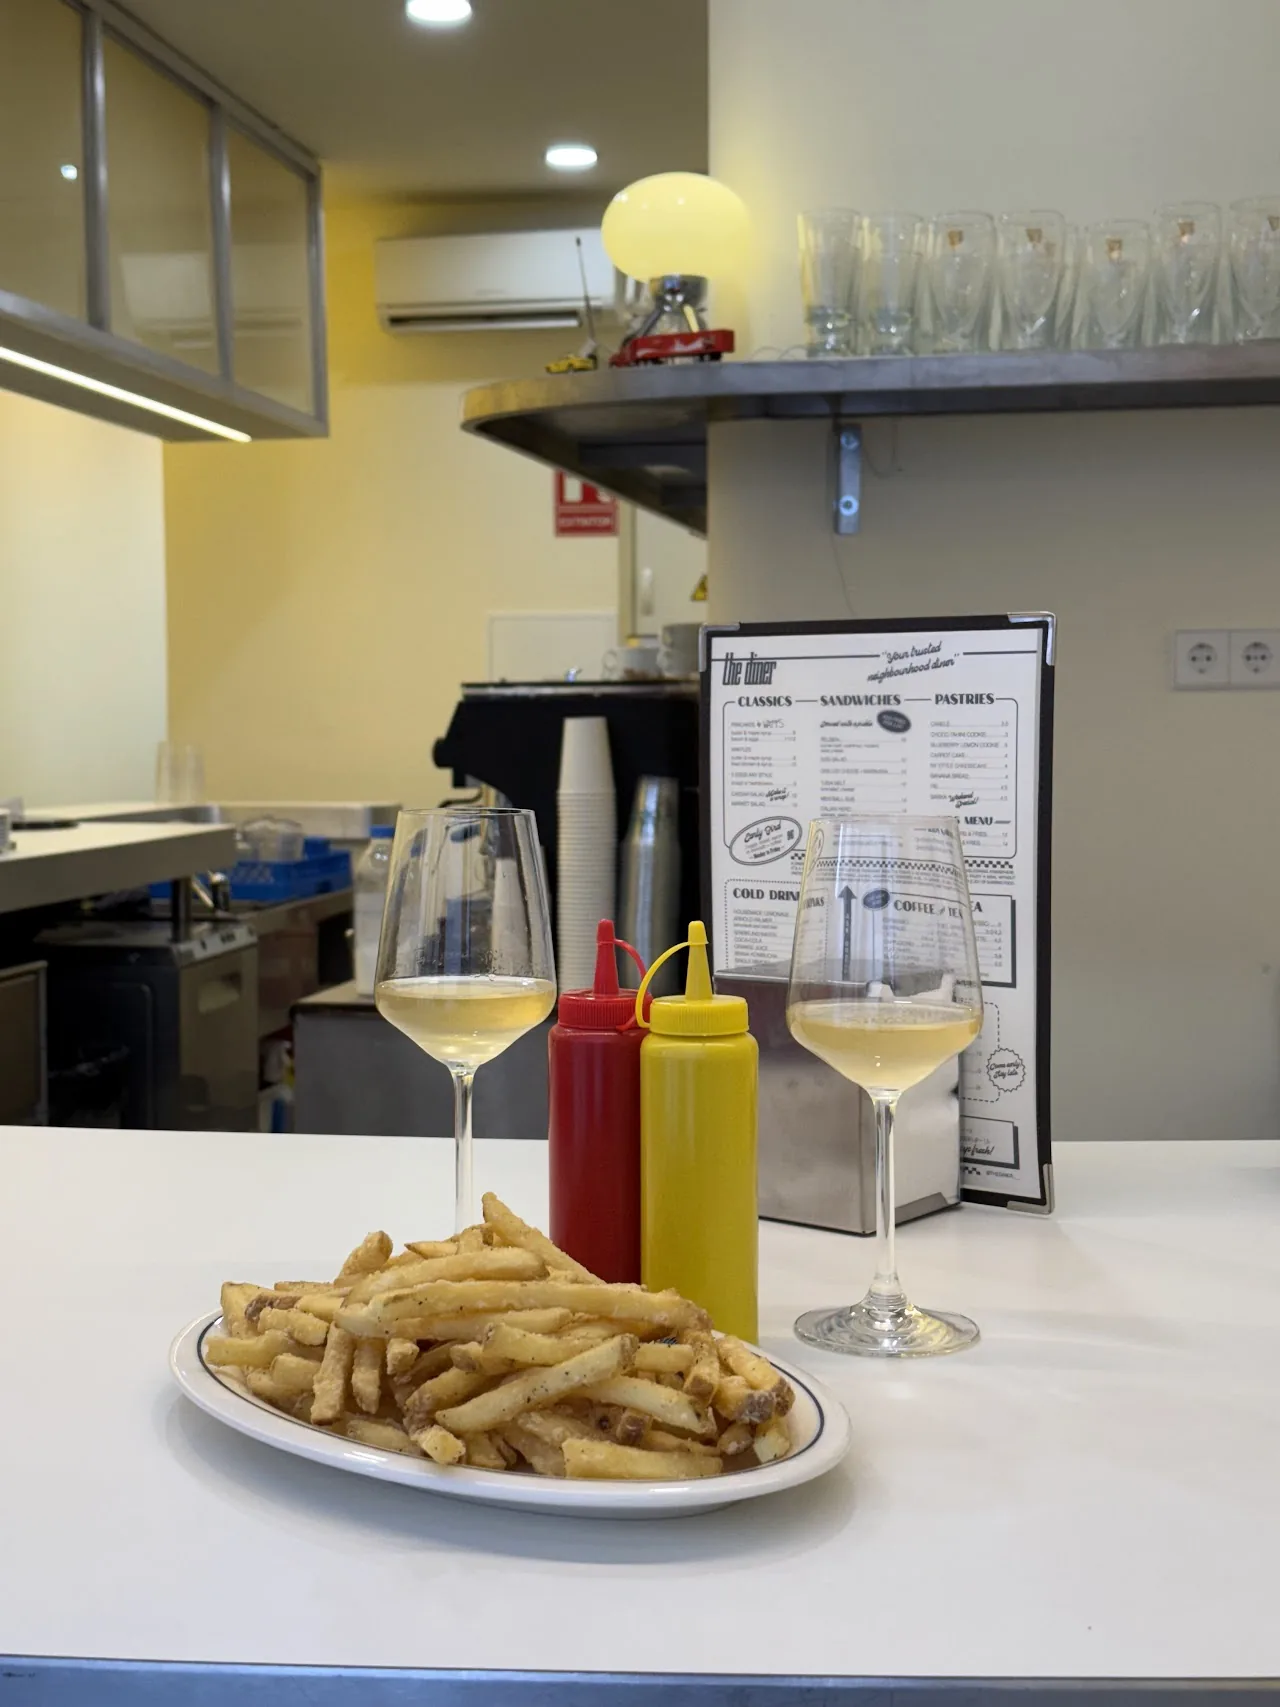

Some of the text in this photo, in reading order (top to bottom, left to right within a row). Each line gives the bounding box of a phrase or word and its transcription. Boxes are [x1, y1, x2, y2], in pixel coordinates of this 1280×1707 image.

[910, 641, 942, 658] trusted
[722, 652, 777, 686] the diner
[867, 658, 932, 684] neighbourhood
[738, 695, 792, 707] CLASSICS
[820, 694, 901, 706] SANDWICHES
[935, 693, 995, 705] PASTRIES
[763, 820, 782, 836] Bird
[964, 816, 994, 826] MENU
[733, 888, 765, 900] COLD
[893, 899, 936, 915] COFFEE
